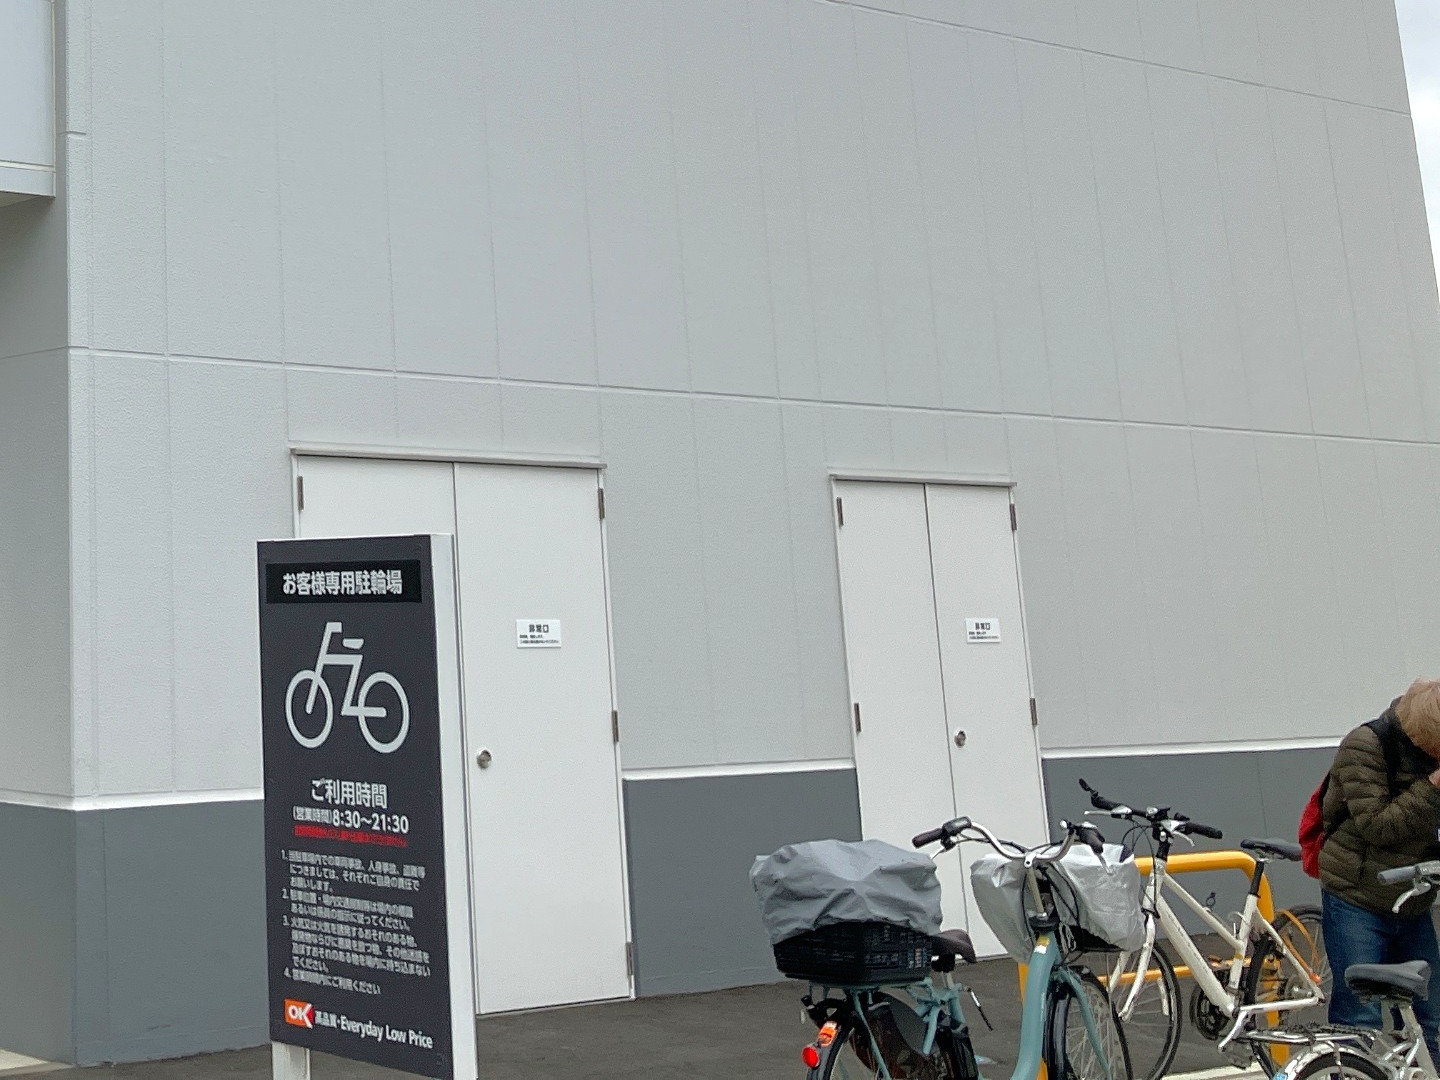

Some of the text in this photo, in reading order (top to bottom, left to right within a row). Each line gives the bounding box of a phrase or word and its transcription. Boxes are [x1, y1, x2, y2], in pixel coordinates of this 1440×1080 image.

[283, 570, 402, 595] お客様専用駐輪場
[312, 778, 387, 809] ご利用時間
[288, 1003, 313, 1028] OK
[386, 1025, 407, 1043] Low
[409, 1031, 433, 1049] Price
